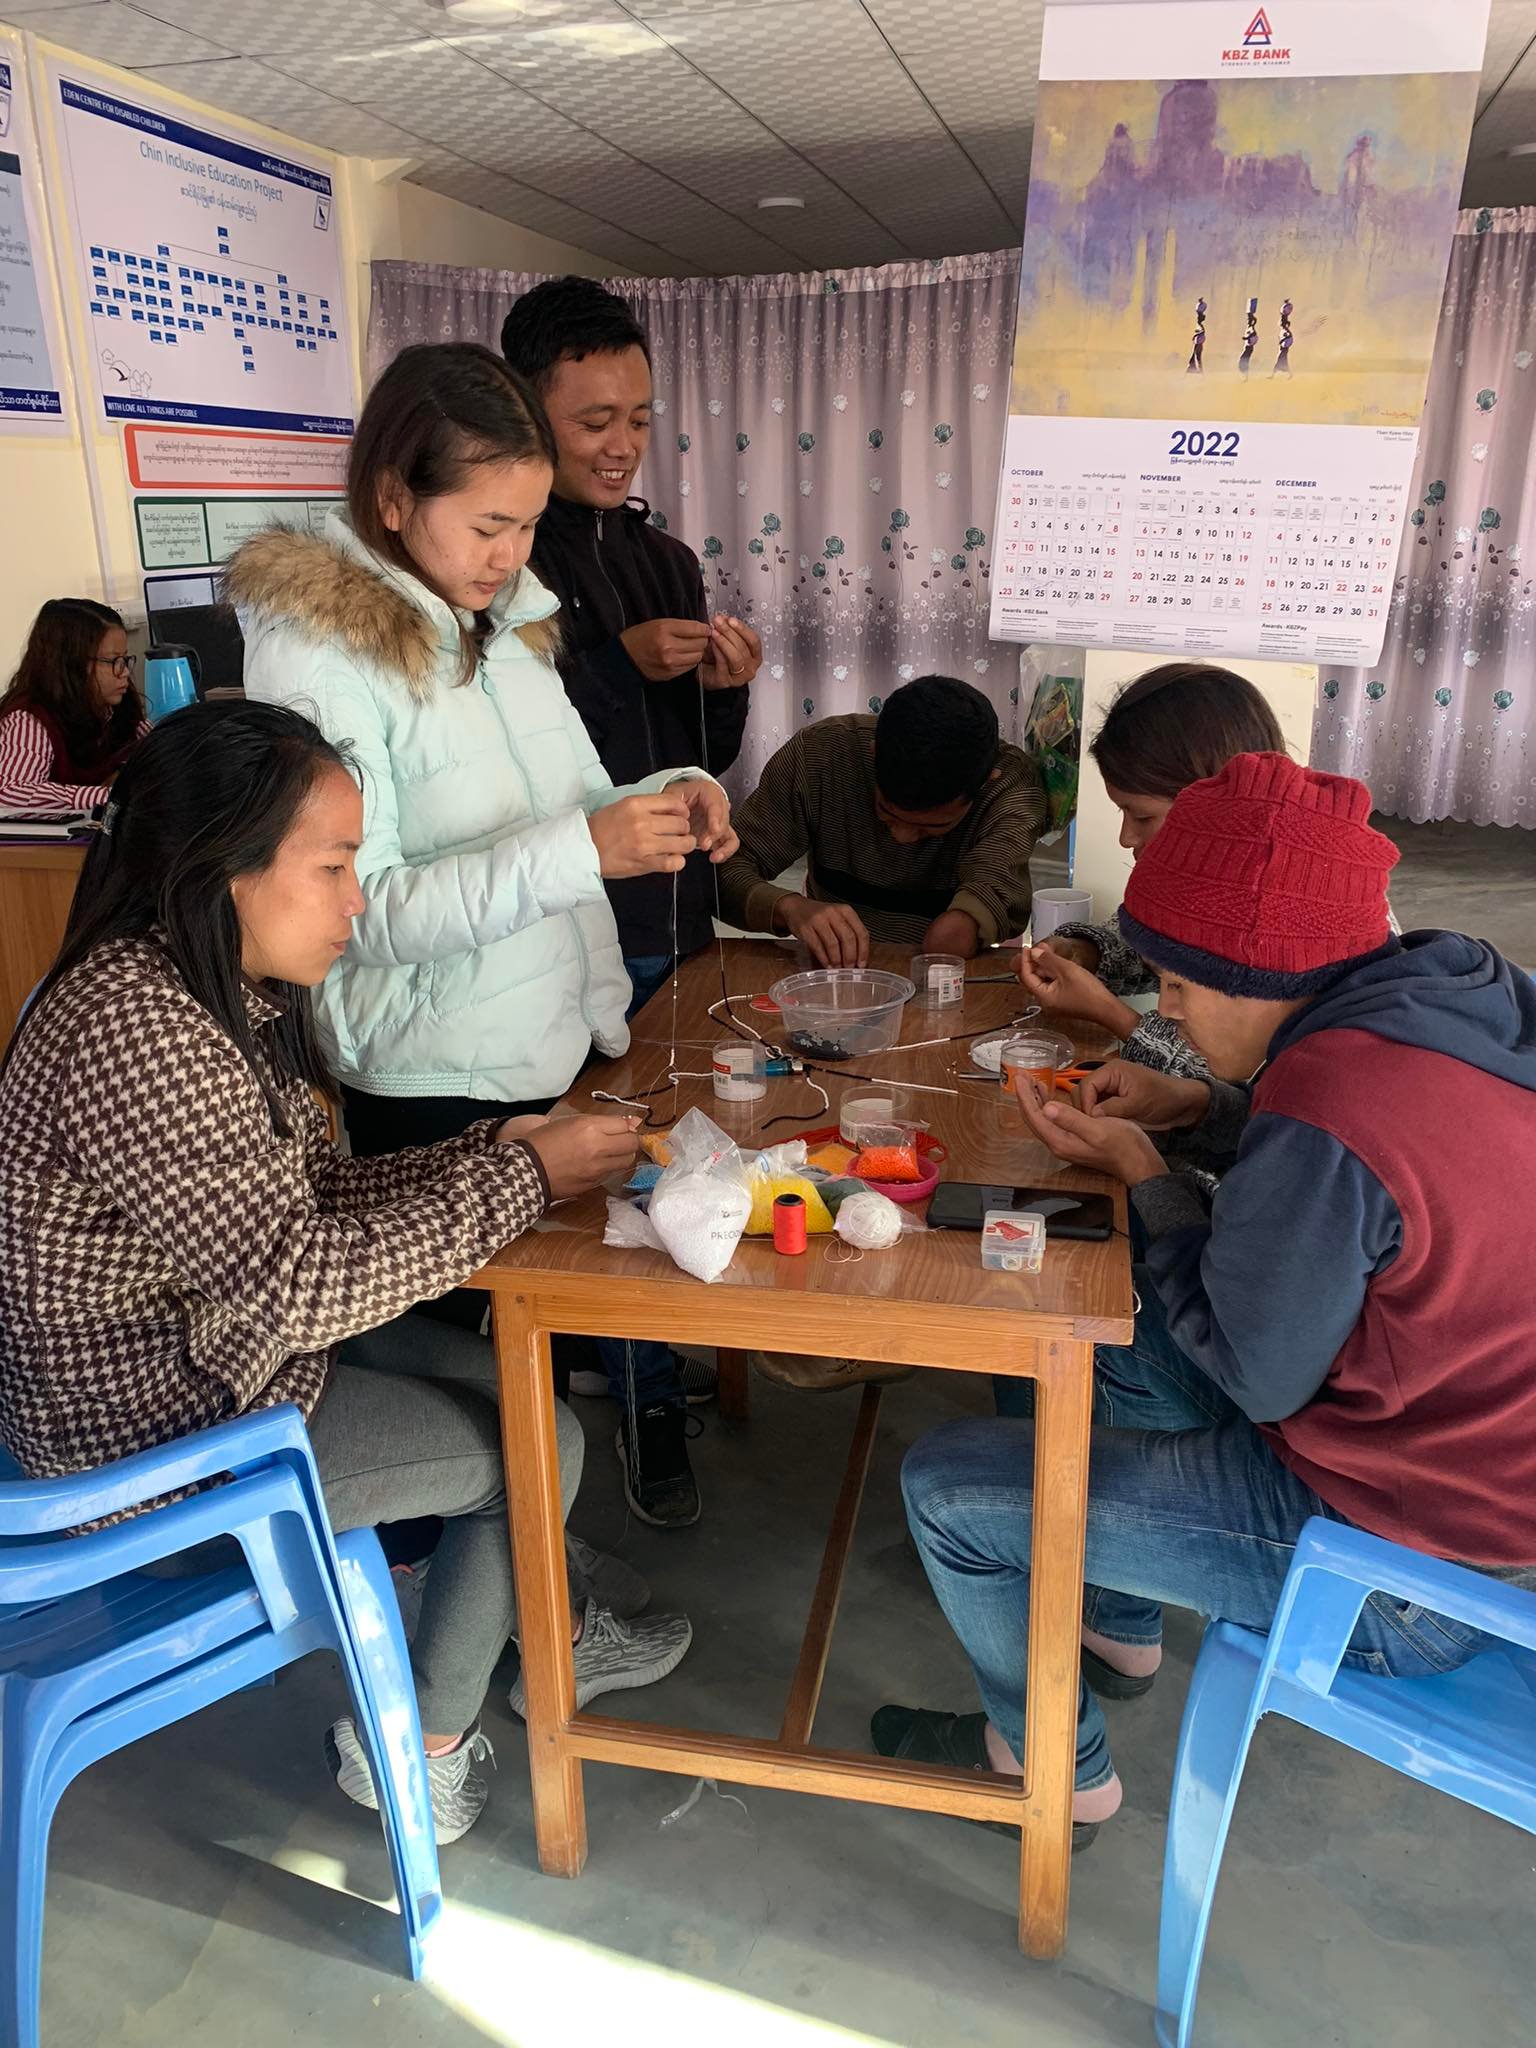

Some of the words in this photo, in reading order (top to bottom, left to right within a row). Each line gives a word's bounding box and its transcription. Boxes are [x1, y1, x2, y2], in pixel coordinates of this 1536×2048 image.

[1221, 49, 1250, 60] KBZ
[1253, 48, 1291, 59] BANK
[63, 87, 80, 101] EDEN
[80, 92, 102, 110] CENTRE
[102, 103, 115, 114] FOR
[115, 106, 140, 123] DISABLED
[140, 116, 167, 133] CHILDREN
[139, 141, 163, 161] Chin
[164, 148, 206, 178] Inclusive
[207, 163, 252, 192] Education
[254, 178, 284, 202] Project
[106, 402, 122, 411] WITH
[122, 403, 136, 412] LOVE
[136, 404, 146, 413] ALL
[145, 405, 165, 415] THINGS
[164, 407, 175, 416] ARE
[175, 408, 198, 418] POSSIBLE
[1168, 430, 1240, 457] 2022
[1010, 469, 1044, 477] OCTOBER
[1139, 474, 1182, 482] NOVEMBER
[1275, 479, 1317, 488] DECEMBER
[1010, 497, 1022, 505] 30
[1028, 498, 1038, 506] 31
[1198, 505, 1204, 513] 2
[1215, 506, 1221, 514] 3
[1354, 512, 1358, 520] 1
[1371, 513, 1378, 521] 2
[1389, 514, 1395, 522] 3
[1013, 520, 1019, 528] 2
[1031, 521, 1036, 529] 3
[1080, 523, 1085, 531] 6
[1113, 525, 1119, 533] 8
[1160, 527, 1167, 535] 7
[1207, 529, 1218, 537] 10
[1225, 530, 1234, 538] 11
[1242, 531, 1252, 539] 12
[1277, 533, 1283, 541] 4
[1295, 534, 1301, 542] 5
[1312, 535, 1318, 543] 6
[1368, 537, 1373, 545] 9
[1380, 538, 1391, 546] 10
[1011, 543, 1017, 551] 9
[1040, 544, 1049, 552] 11
[1057, 545, 1067, 553] 12
[1073, 546, 1083, 554] 13
[1136, 549, 1145, 557] 13
[1153, 550, 1163, 558] 14
[1170, 551, 1180, 559] 15
[1187, 552, 1197, 560] 16
[1204, 553, 1215, 561] 17
[1222, 554, 1232, 562] 18
[1239, 554, 1249, 562] 19
[1269, 556, 1278, 564] 11
[1288, 557, 1298, 565] 12
[1305, 558, 1315, 566] 13
[1323, 559, 1333, 567] 14
[1341, 560, 1351, 568] 15
[1359, 561, 1369, 569] 16
[1376, 562, 1387, 570] 17
[1005, 565, 1014, 573] 16
[1022, 566, 1032, 574] 17
[1038, 567, 1047, 575] 18
[1055, 568, 1064, 576] 19
[1087, 570, 1096, 578] 21
[1132, 572, 1143, 580] 20
[1149, 573, 1159, 581] 21
[1166, 574, 1177, 582] 22
[1184, 575, 1194, 583] 23
[1218, 577, 1229, 585] 25
[1234, 578, 1245, 586] 26
[1266, 580, 1276, 588] 18
[1284, 581, 1294, 589] 19
[1300, 581, 1311, 589] 20
[1319, 583, 1329, 591] 21
[1336, 584, 1348, 592] 22
[1354, 585, 1366, 593] 23
[1372, 586, 1383, 594] 24
[1035, 589, 1045, 597] 25
[1052, 590, 1062, 598] 26
[1068, 591, 1078, 599] 27
[1084, 592, 1095, 600] 28
[1100, 593, 1111, 601] 29
[1147, 596, 1157, 604] 28
[1163, 597, 1174, 605] 29
[1181, 598, 1191, 606] 30
[1262, 602, 1272, 611] 25
[1280, 603, 1291, 612] 26
[1296, 604, 1307, 613] 27
[1315, 606, 1326, 614] 28
[1332, 607, 1344, 615] 29
[1350, 608, 1362, 616] 30
[1367, 609, 1378, 617] 31
